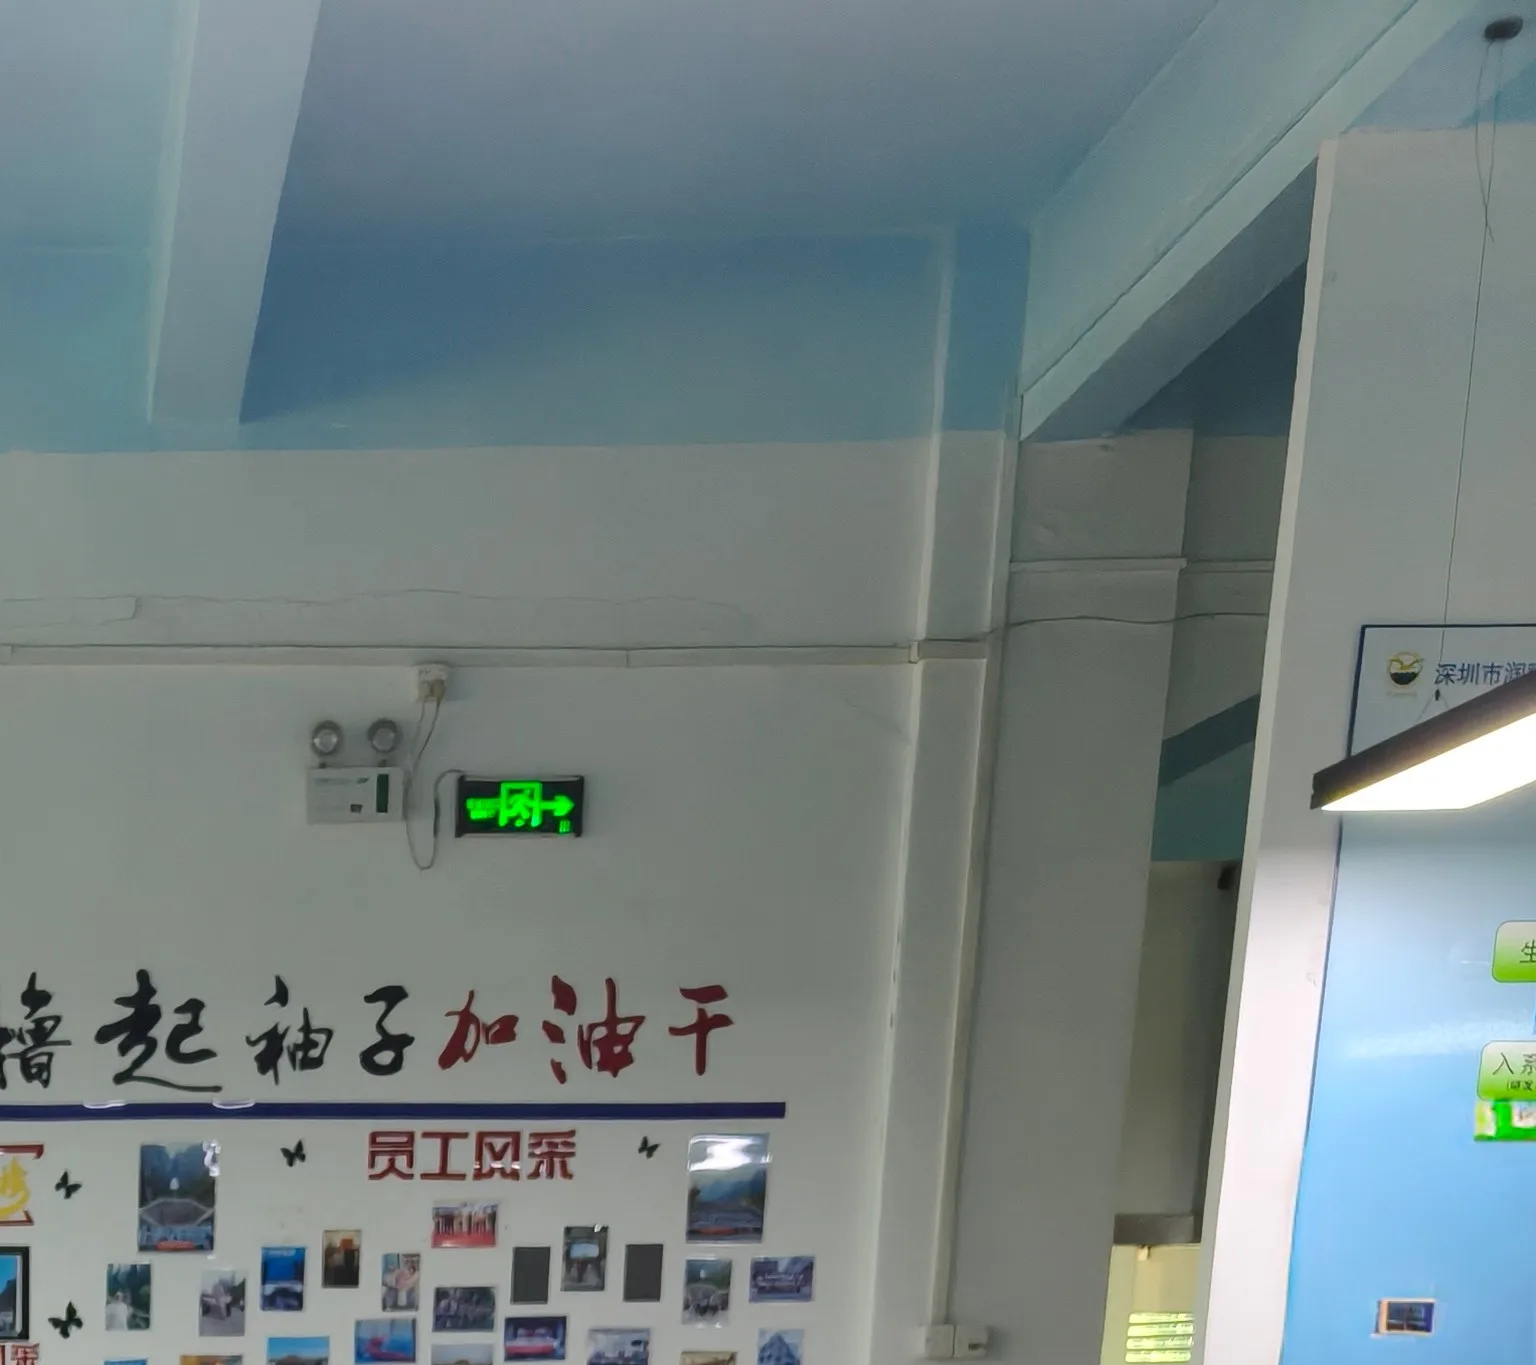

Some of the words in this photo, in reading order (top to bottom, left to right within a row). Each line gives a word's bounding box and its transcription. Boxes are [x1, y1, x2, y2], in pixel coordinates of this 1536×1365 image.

[1434, 662, 1536, 686] 深圳市润
[368, 1129, 576, 1181] 员工风采
